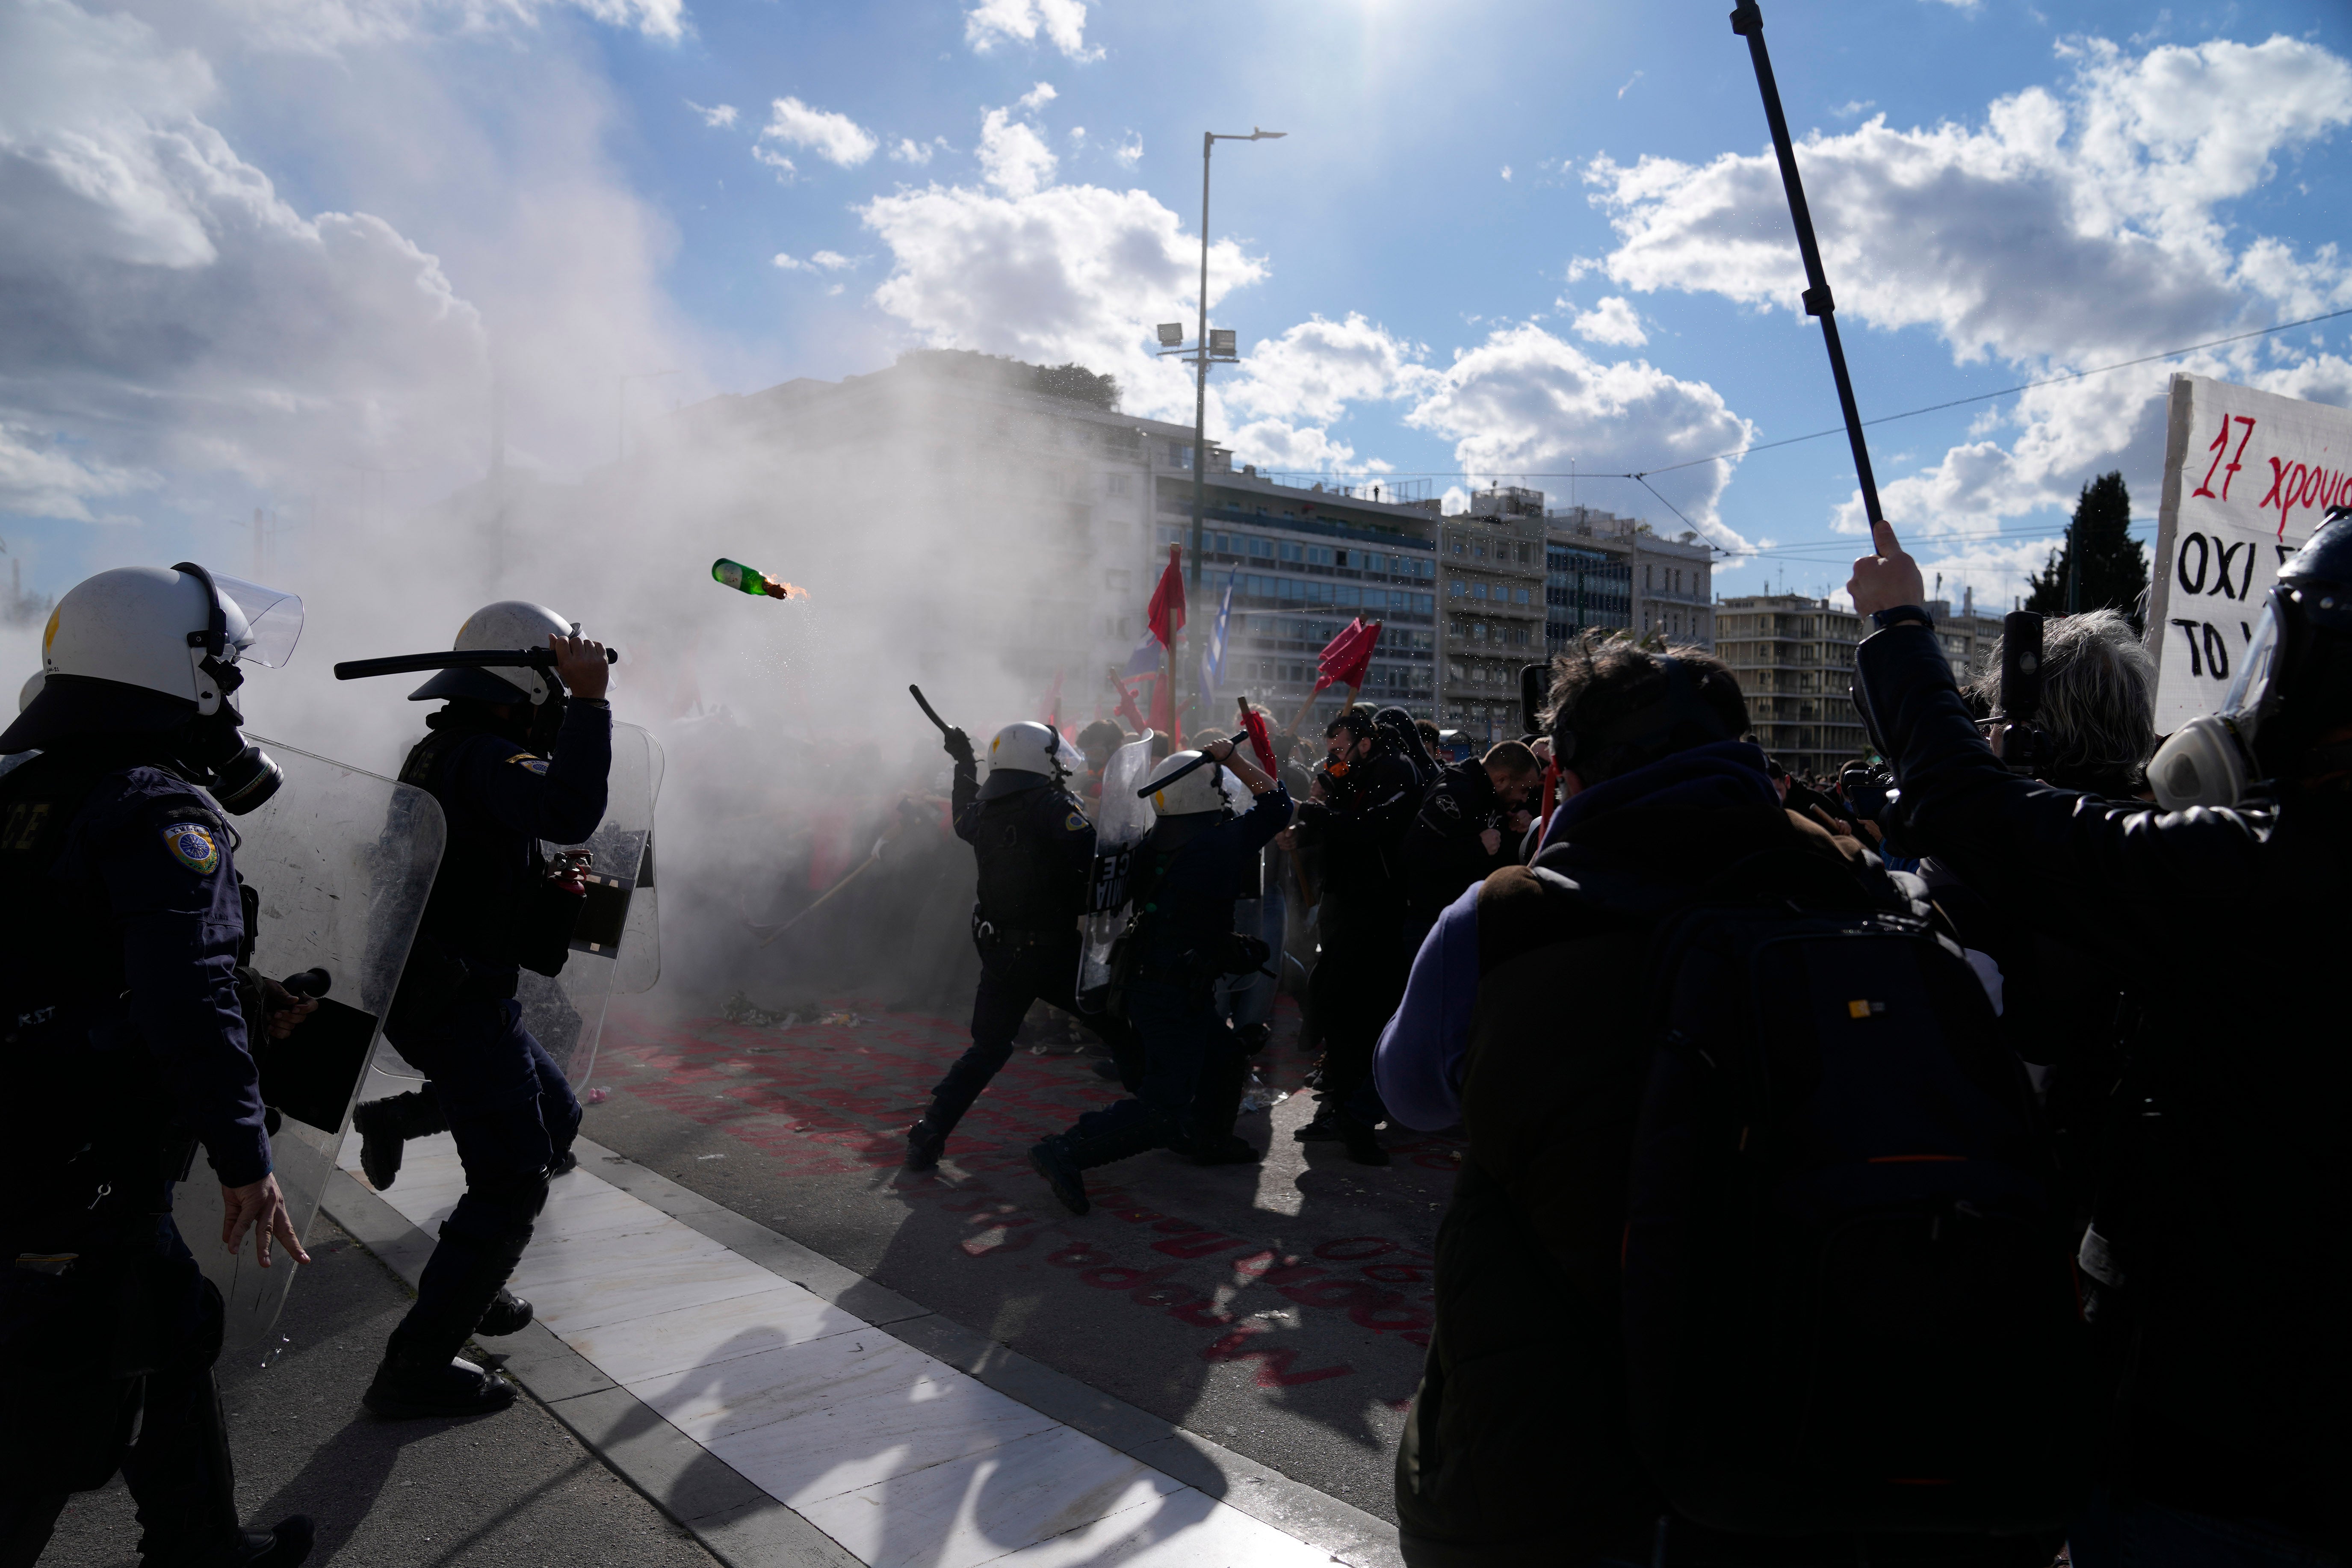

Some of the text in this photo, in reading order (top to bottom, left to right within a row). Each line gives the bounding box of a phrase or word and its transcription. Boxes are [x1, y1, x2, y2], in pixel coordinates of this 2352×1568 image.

[2192, 413, 2256, 502] 17
[2178, 532, 2256, 602] ΟΧΙ
[2171, 619, 2229, 681] ΤΟ
